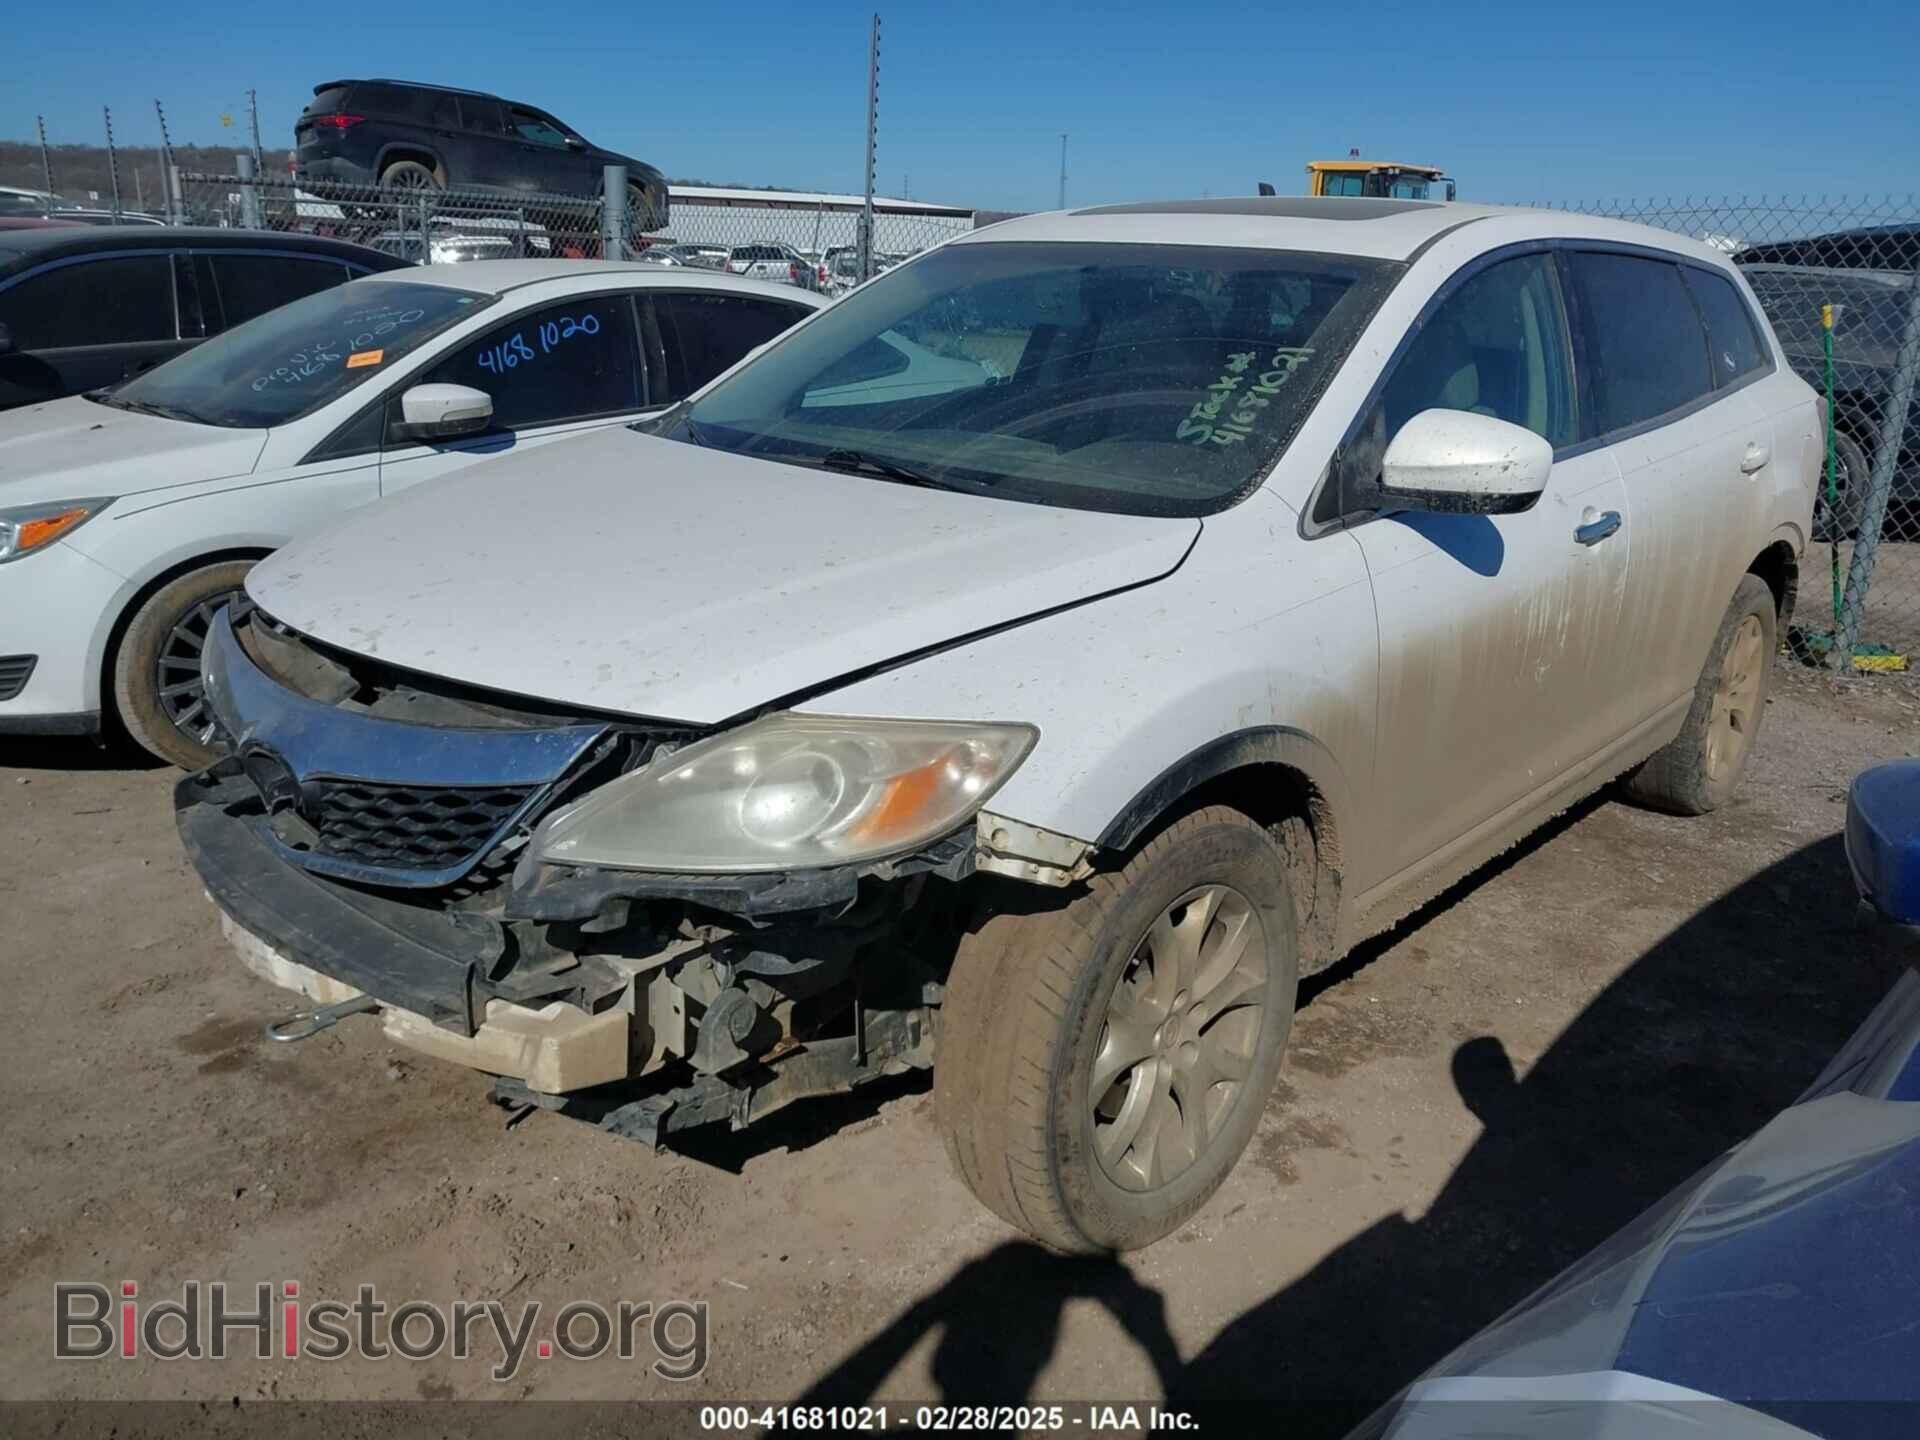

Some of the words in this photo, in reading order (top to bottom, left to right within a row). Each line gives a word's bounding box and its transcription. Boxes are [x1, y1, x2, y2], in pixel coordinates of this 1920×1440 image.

[350, 309, 425, 350] 1020
[478, 333, 535, 374] 4168
[539, 314, 600, 353] 1020
[1210, 347, 1316, 446] 41681021
